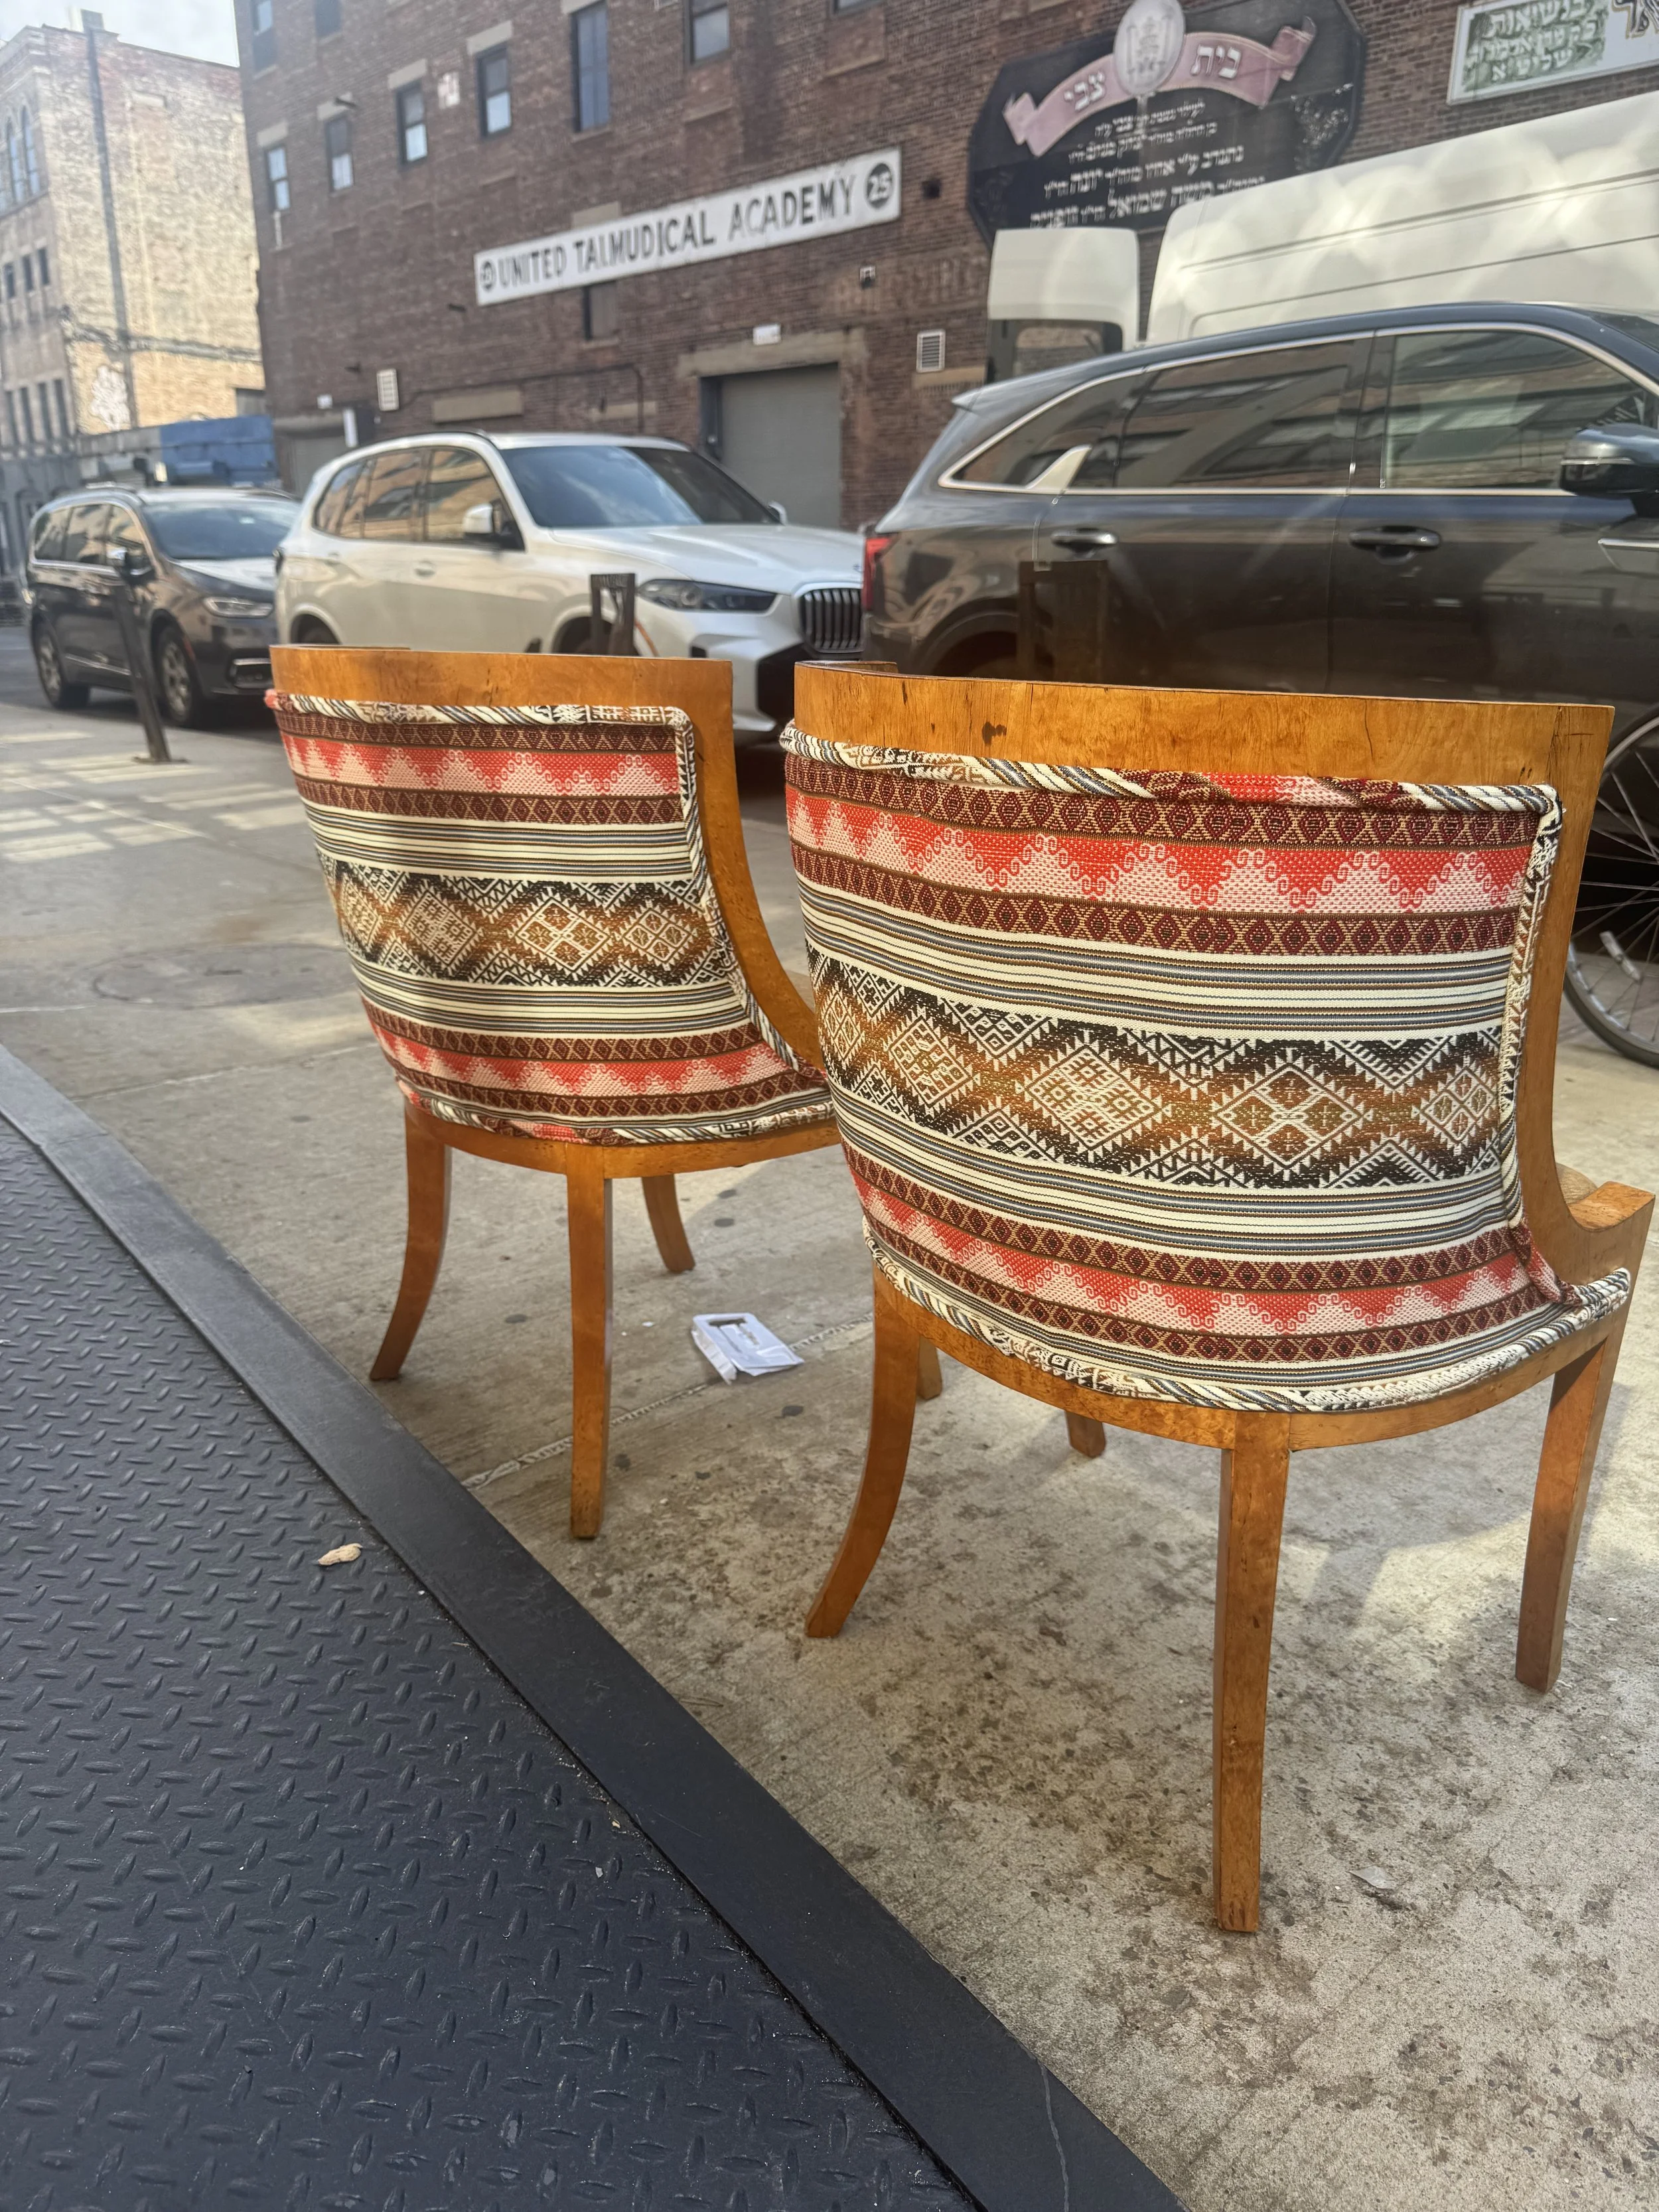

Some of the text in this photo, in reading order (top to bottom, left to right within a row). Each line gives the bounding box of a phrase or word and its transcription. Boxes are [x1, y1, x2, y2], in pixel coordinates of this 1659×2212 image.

[1064, 44, 1241, 111] בית צבי
[498, 246, 567, 287] UNITED
[573, 210, 715, 273] TALMUDICAL
[729, 174, 857, 241] ACADEMY
